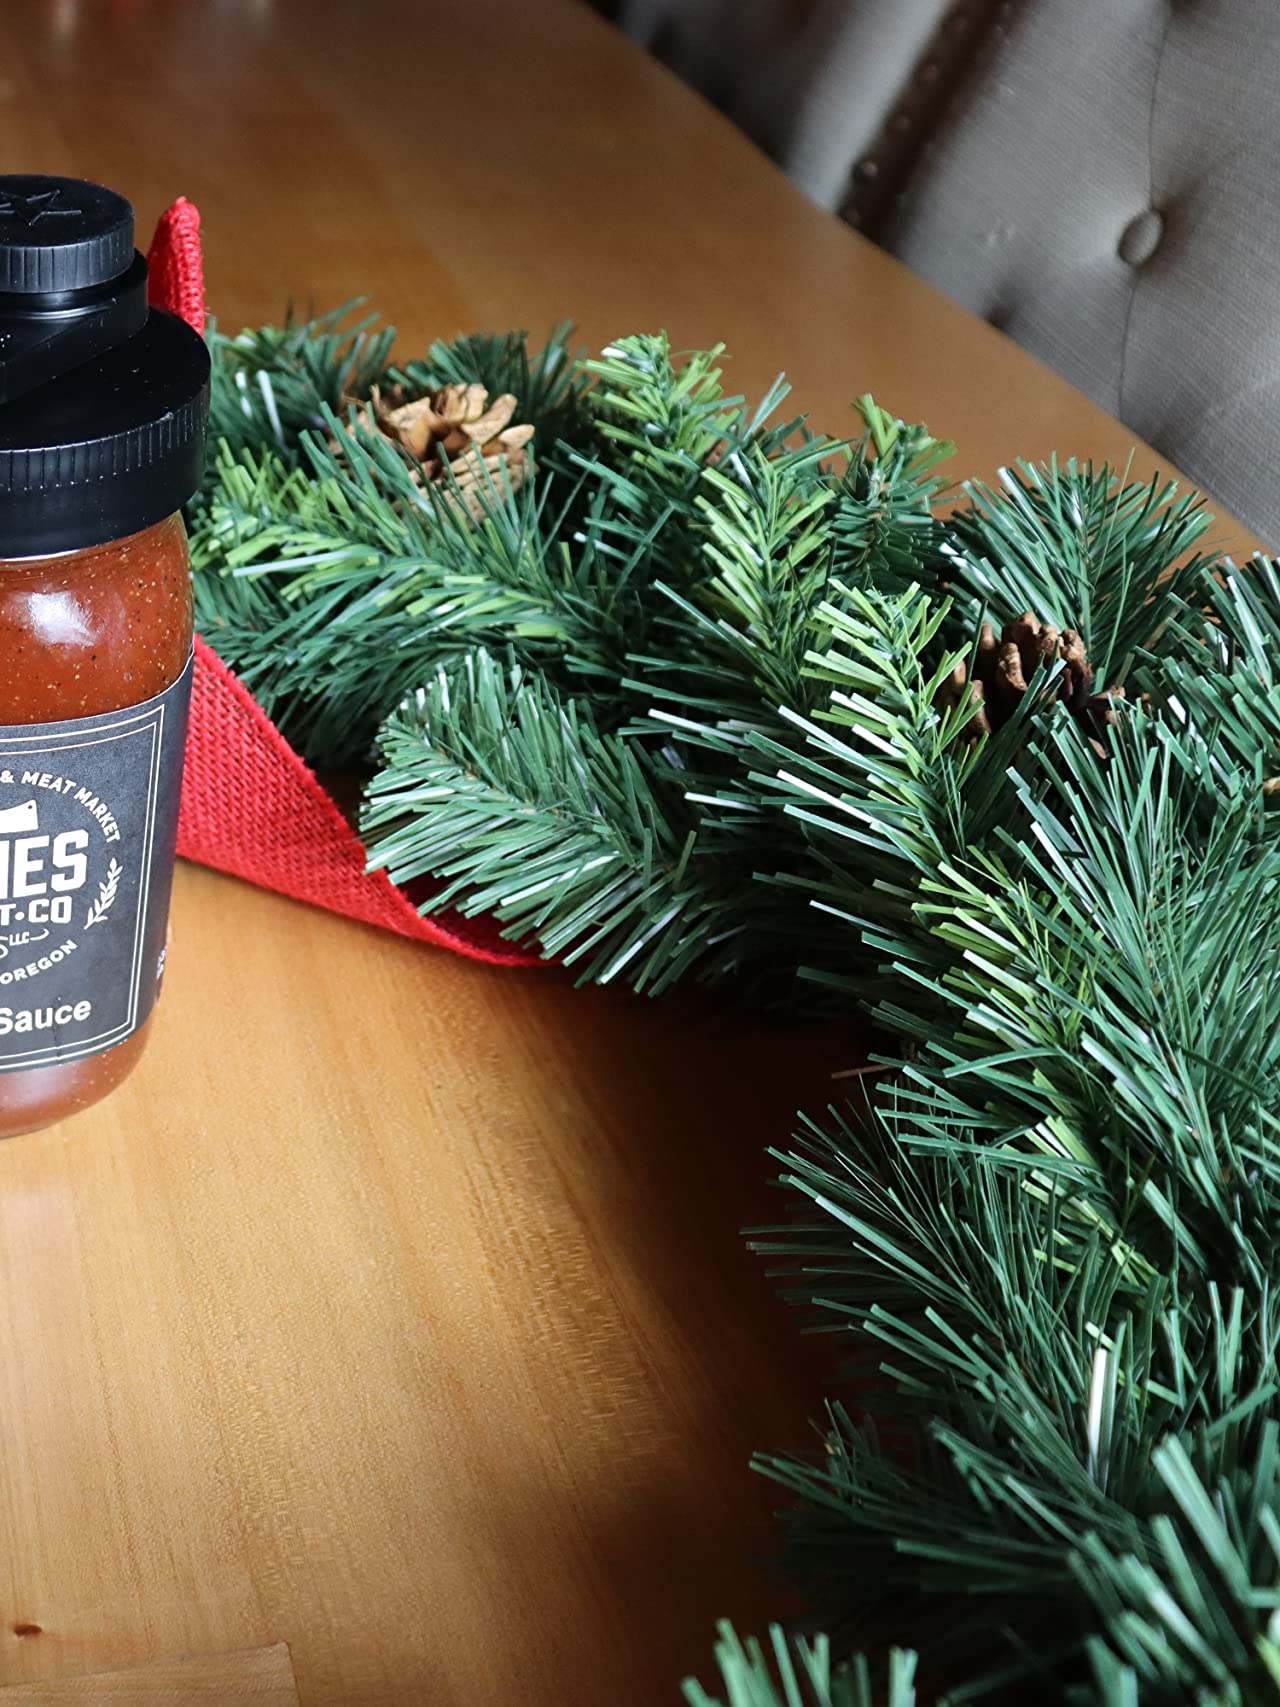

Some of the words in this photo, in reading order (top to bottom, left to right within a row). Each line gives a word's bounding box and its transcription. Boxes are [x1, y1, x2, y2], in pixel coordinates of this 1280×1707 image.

[0, 770, 15, 784] &
[21, 771, 77, 795] MEAT
[73, 786, 121, 844] MARKET
[0, 939, 78, 985] OREGON
[9, 931, 30, 947] LLC
